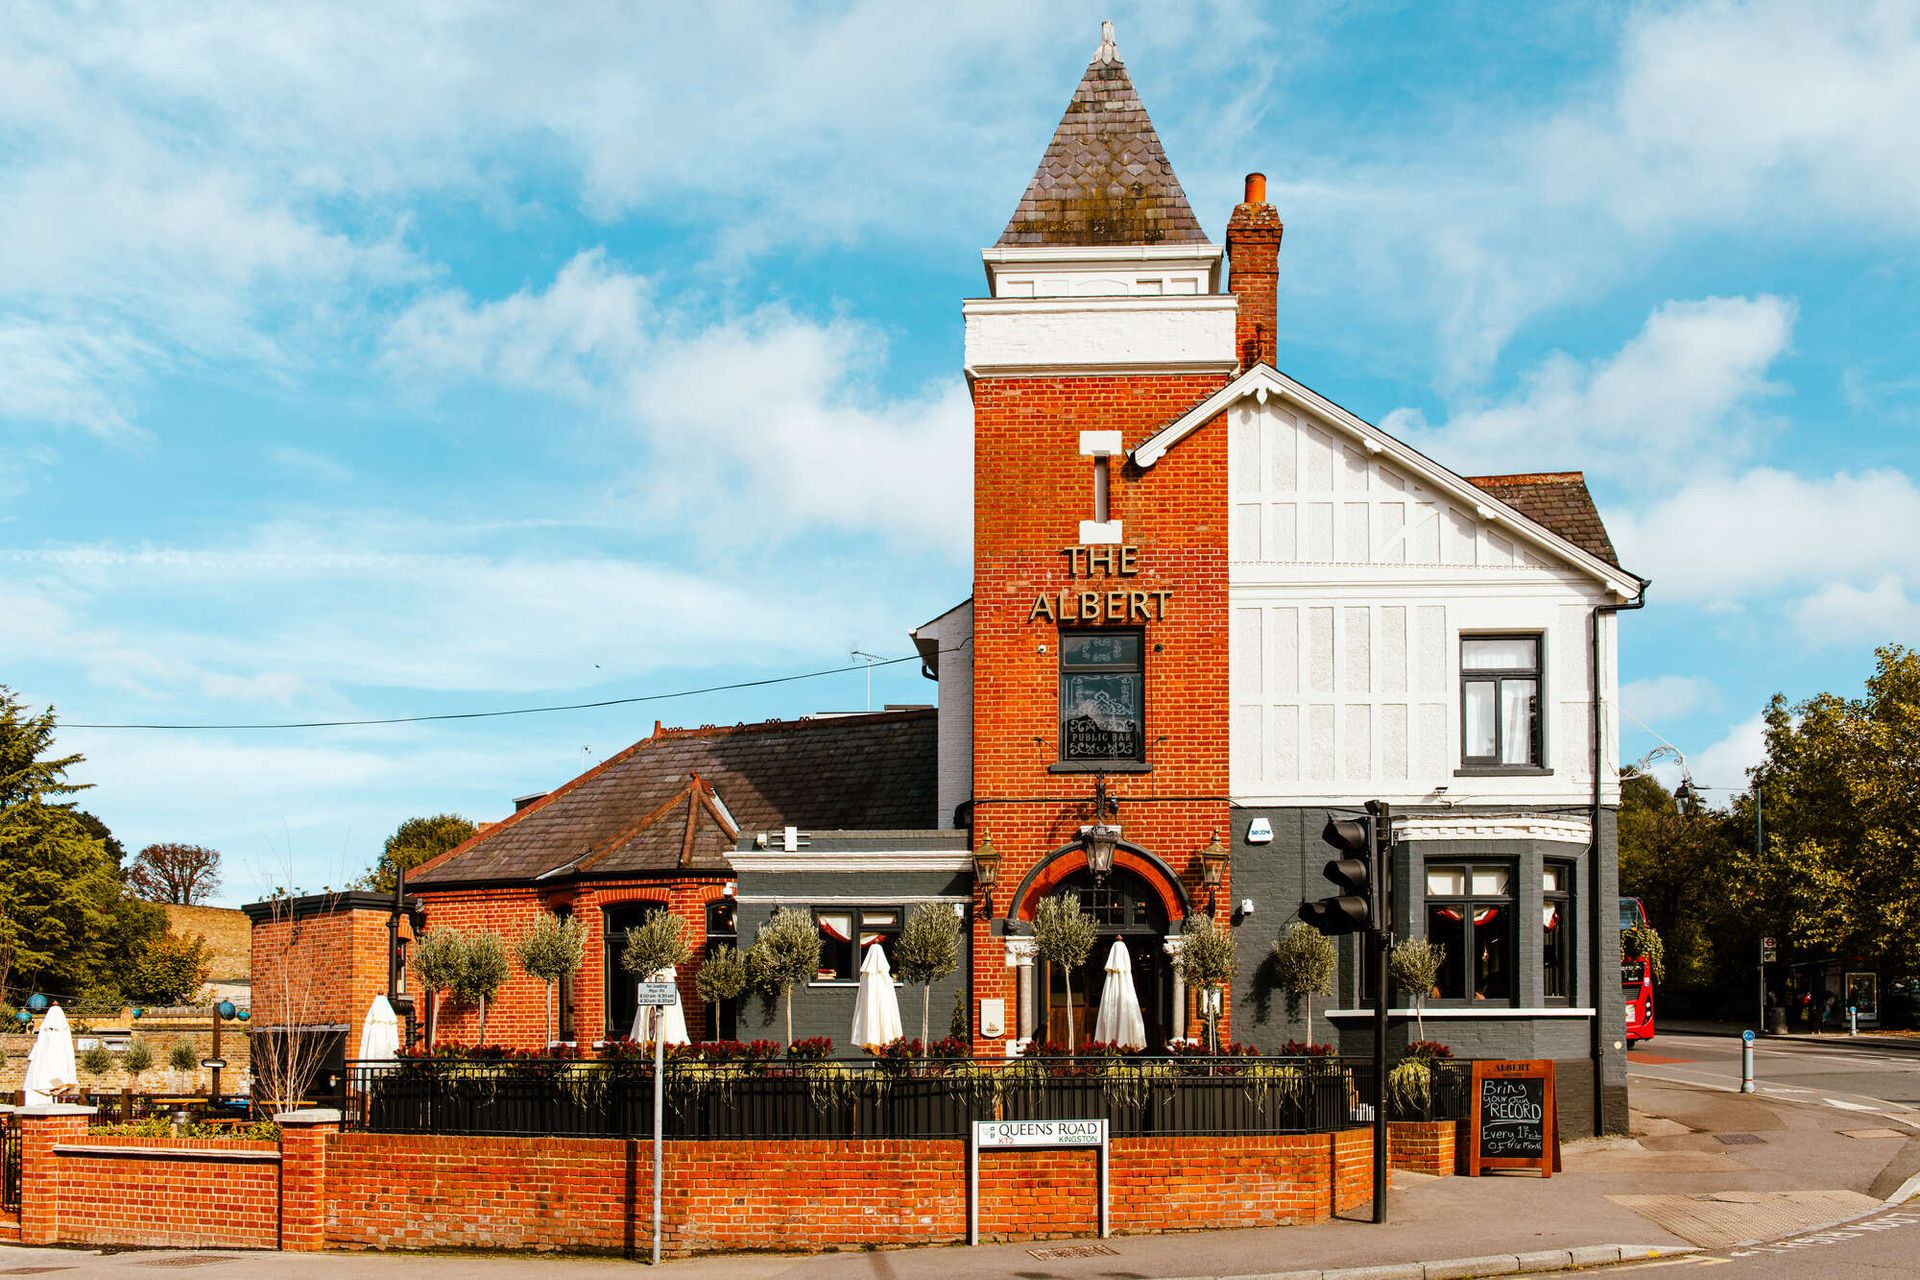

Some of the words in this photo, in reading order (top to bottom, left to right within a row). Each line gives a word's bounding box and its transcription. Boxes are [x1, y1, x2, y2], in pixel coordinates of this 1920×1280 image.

[1063, 546, 1139, 575] THE
[1029, 591, 1174, 621] ALBERT
[1072, 733, 1108, 742] PUBLIC
[1112, 733, 1132, 742] BAR
[1495, 1064, 1530, 1072] ALBERT
[1483, 1081, 1527, 1097] Bring
[1483, 1096, 1507, 1108] your
[1490, 1103, 1541, 1119] RECORD
[999, 1123, 1053, 1137] QUEENS
[1058, 1122, 1098, 1135] ROAD
[1483, 1124, 1515, 1143] Every
